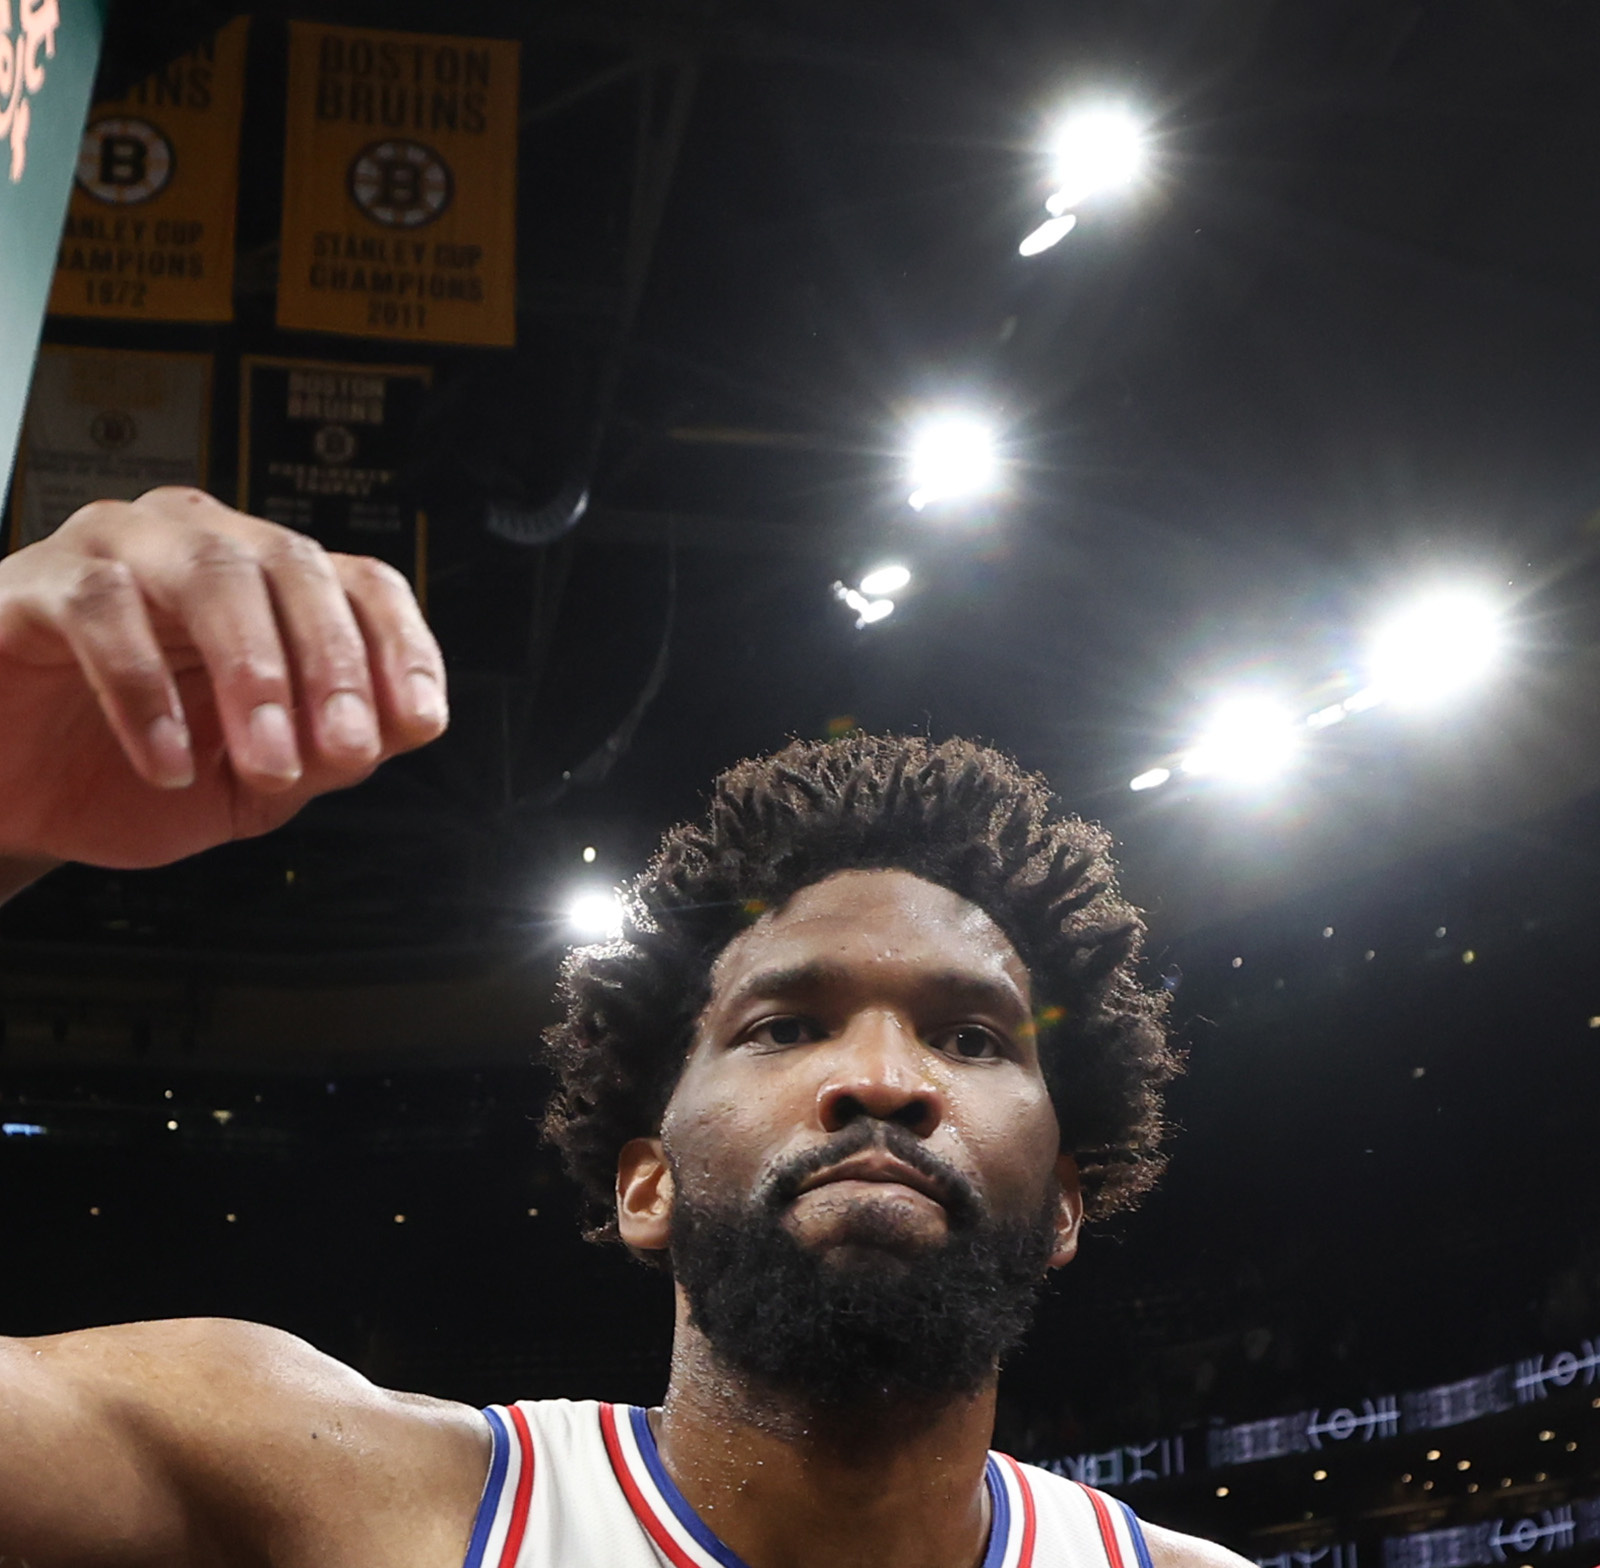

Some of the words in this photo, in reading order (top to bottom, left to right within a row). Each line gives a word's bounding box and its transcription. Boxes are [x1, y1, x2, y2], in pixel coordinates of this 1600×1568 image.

[318, 34, 491, 88] BOSTON
[316, 76, 487, 135] BRUINS
[313, 231, 426, 266] STANLEY
[433, 244, 482, 270] CUP
[310, 265, 484, 305] CHAMPIONS
[367, 302, 426, 330] 2011
